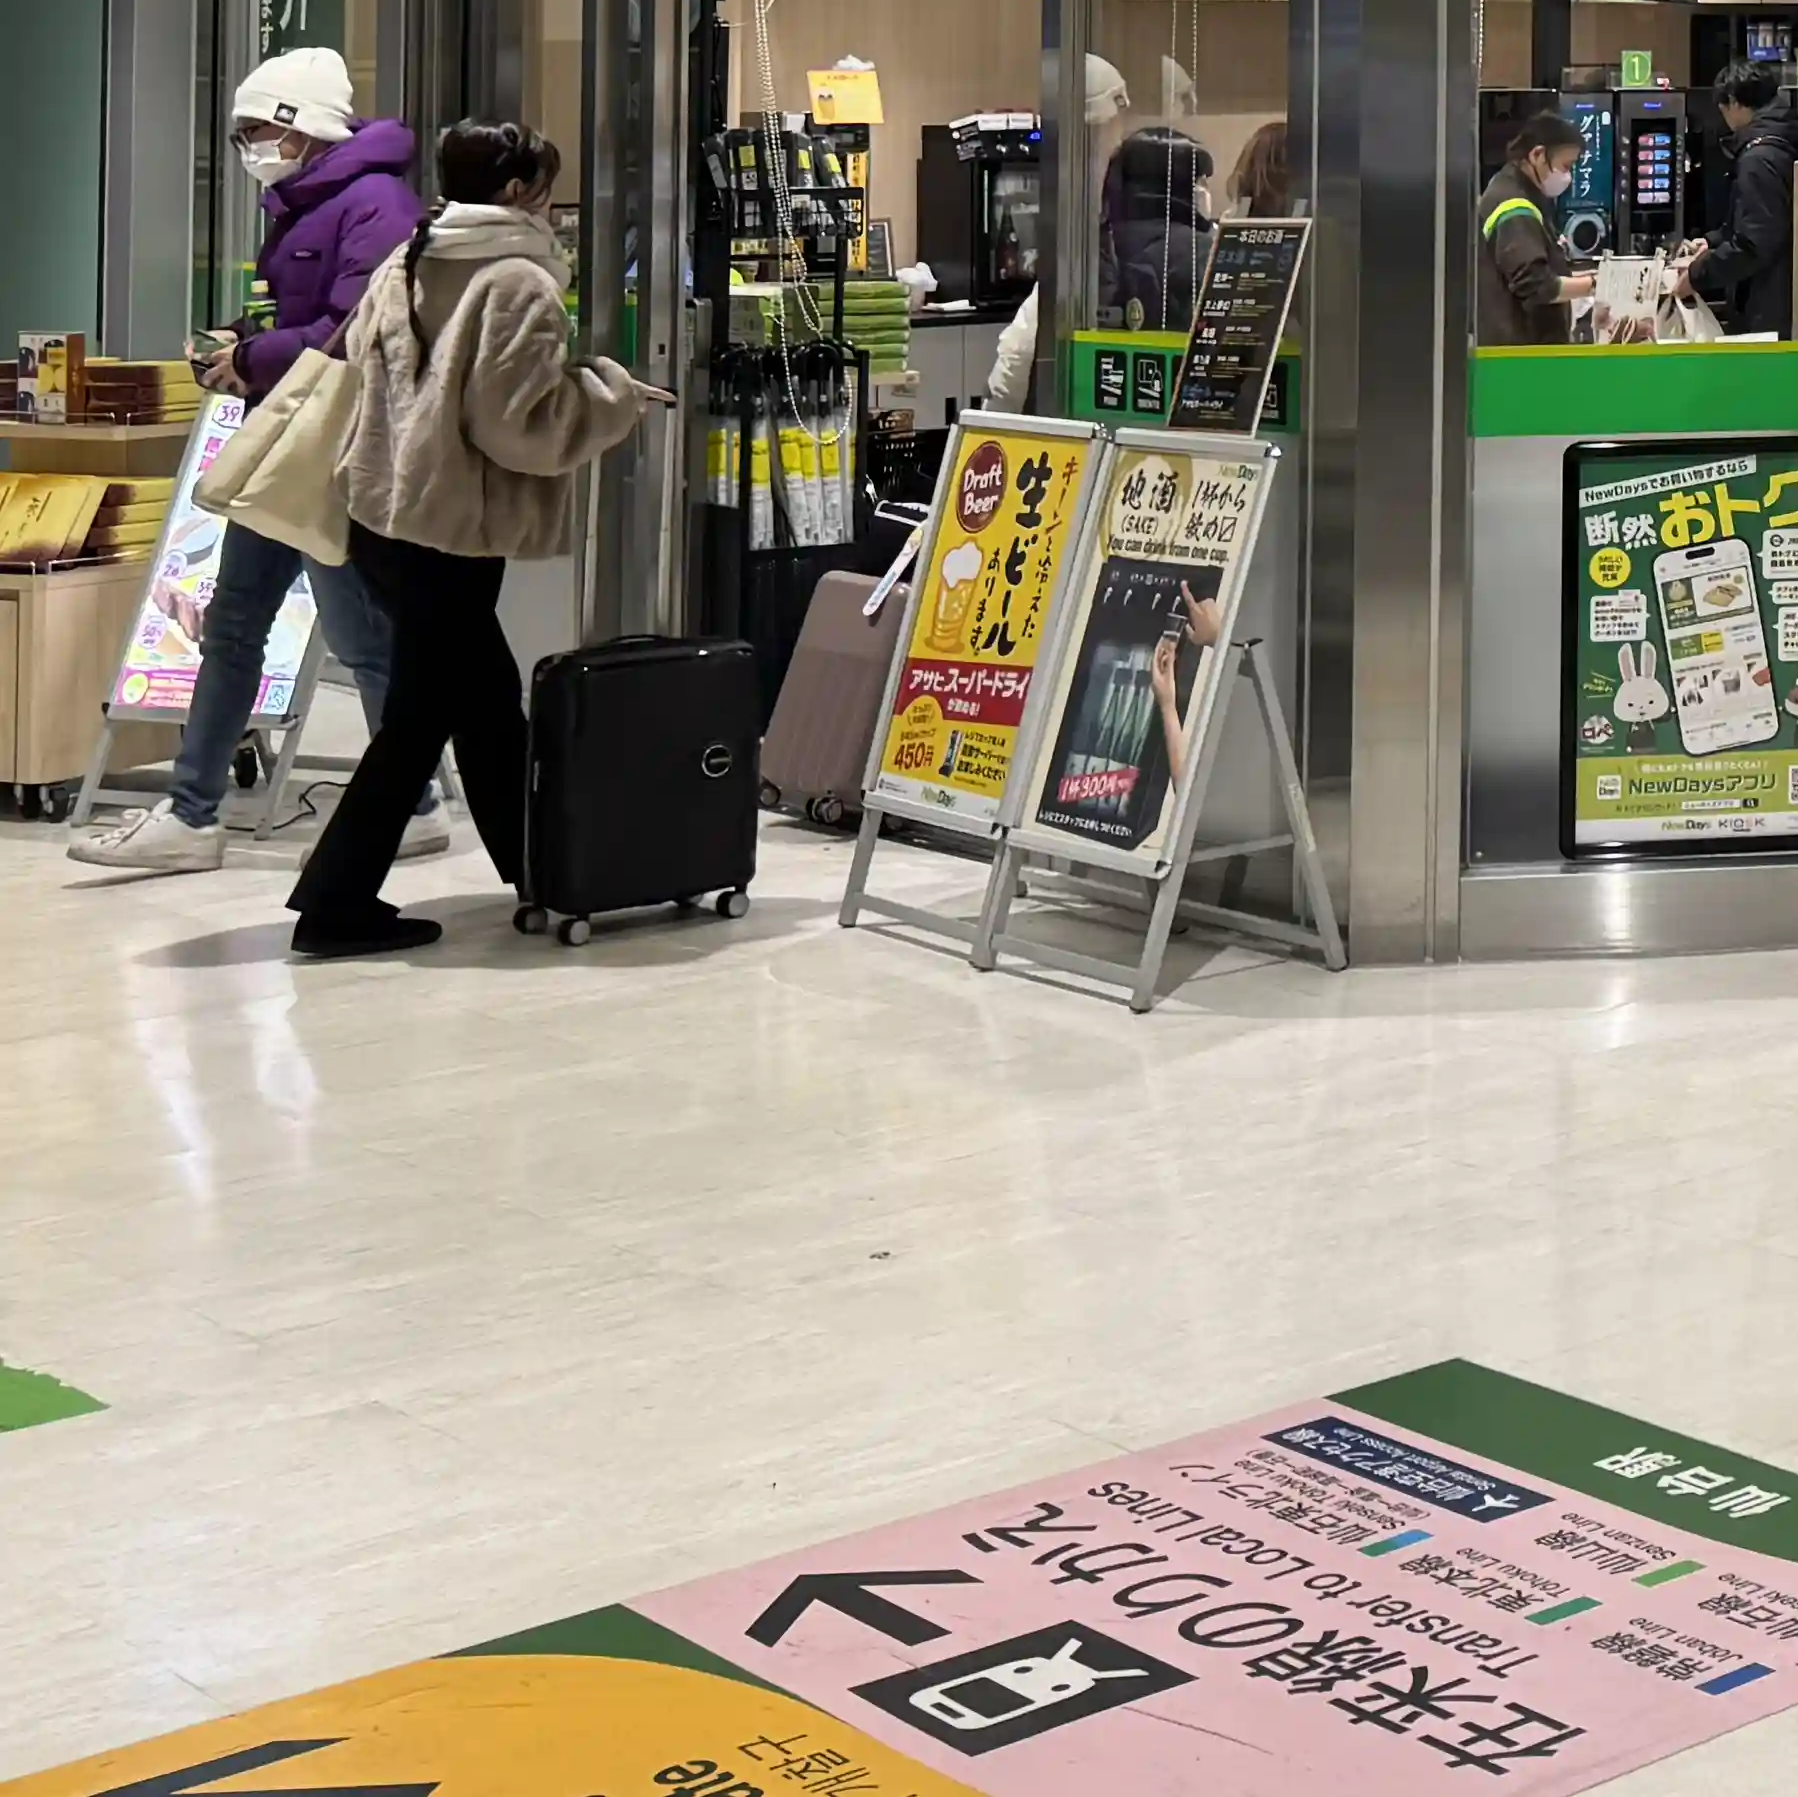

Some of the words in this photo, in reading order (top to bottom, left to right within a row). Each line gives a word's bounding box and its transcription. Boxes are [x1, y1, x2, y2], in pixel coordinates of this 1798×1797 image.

[963, 464, 1002, 491] Draft
[1121, 468, 1179, 514] 地酒
[964, 494, 999, 515] Beer
[982, 452, 1052, 656] 生ビール
[1125, 538, 1142, 553] can
[1168, 542, 1191, 557] from
[1191, 546, 1209, 559] one
[894, 742, 934, 770] 450円
[1628, 773, 1777, 796] NewDaysアプリ
[1661, 819, 1711, 831] NewDays
[1234, 1459, 1275, 1479] Line
[1593, 1446, 1791, 1518] 仙台駅
[1095, 1478, 1204, 1546] Lines
[1167, 1460, 1379, 1546] 仙石東北ライン
[1561, 1511, 1604, 1532] Line
[1194, 1520, 1316, 1581] Local
[1456, 1547, 1502, 1566] Line
[1534, 1528, 1647, 1577] 仙山線
[1605, 1528, 1677, 1561] Senzan
[1304, 1572, 1363, 1602] to
[1398, 1553, 1545, 1613] 東北本線
[1718, 1571, 1765, 1593] Line
[961, 1502, 1588, 1776] 在来線のりかえ
[1368, 1594, 1541, 1680] Transfer
[1628, 1616, 1673, 1637] Line
